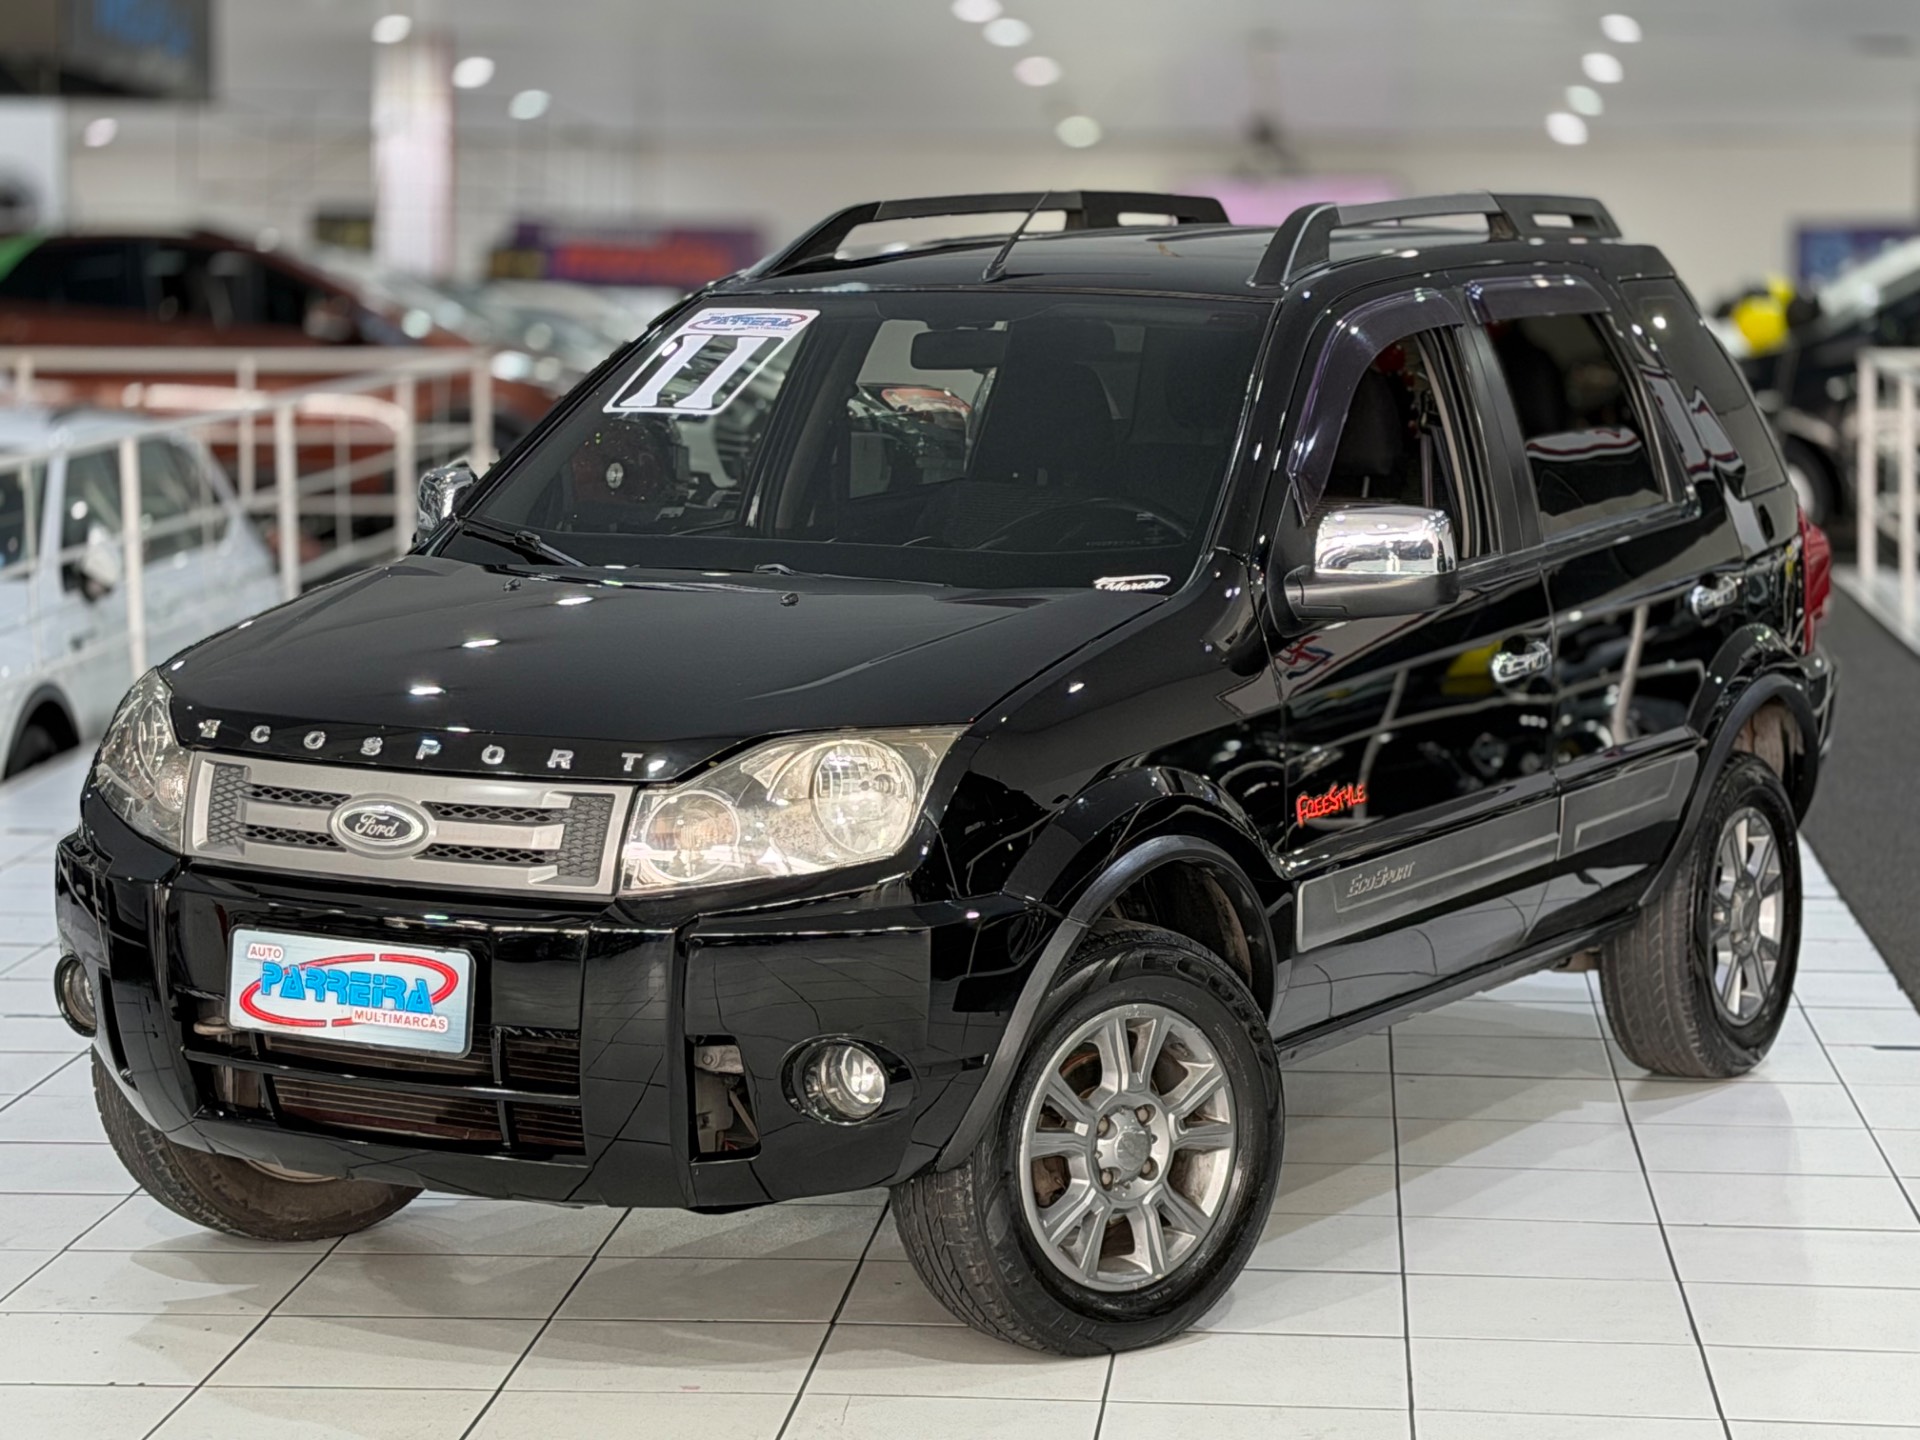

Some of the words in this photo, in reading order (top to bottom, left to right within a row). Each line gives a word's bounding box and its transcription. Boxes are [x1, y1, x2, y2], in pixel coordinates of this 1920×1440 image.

[199, 719, 644, 772] ECOSPORT
[355, 812, 400, 837] Ford
[249, 946, 282, 959] AUTO
[260, 961, 434, 1014] PARREIRA
[354, 1010, 446, 1030] MULTIMARCAS
